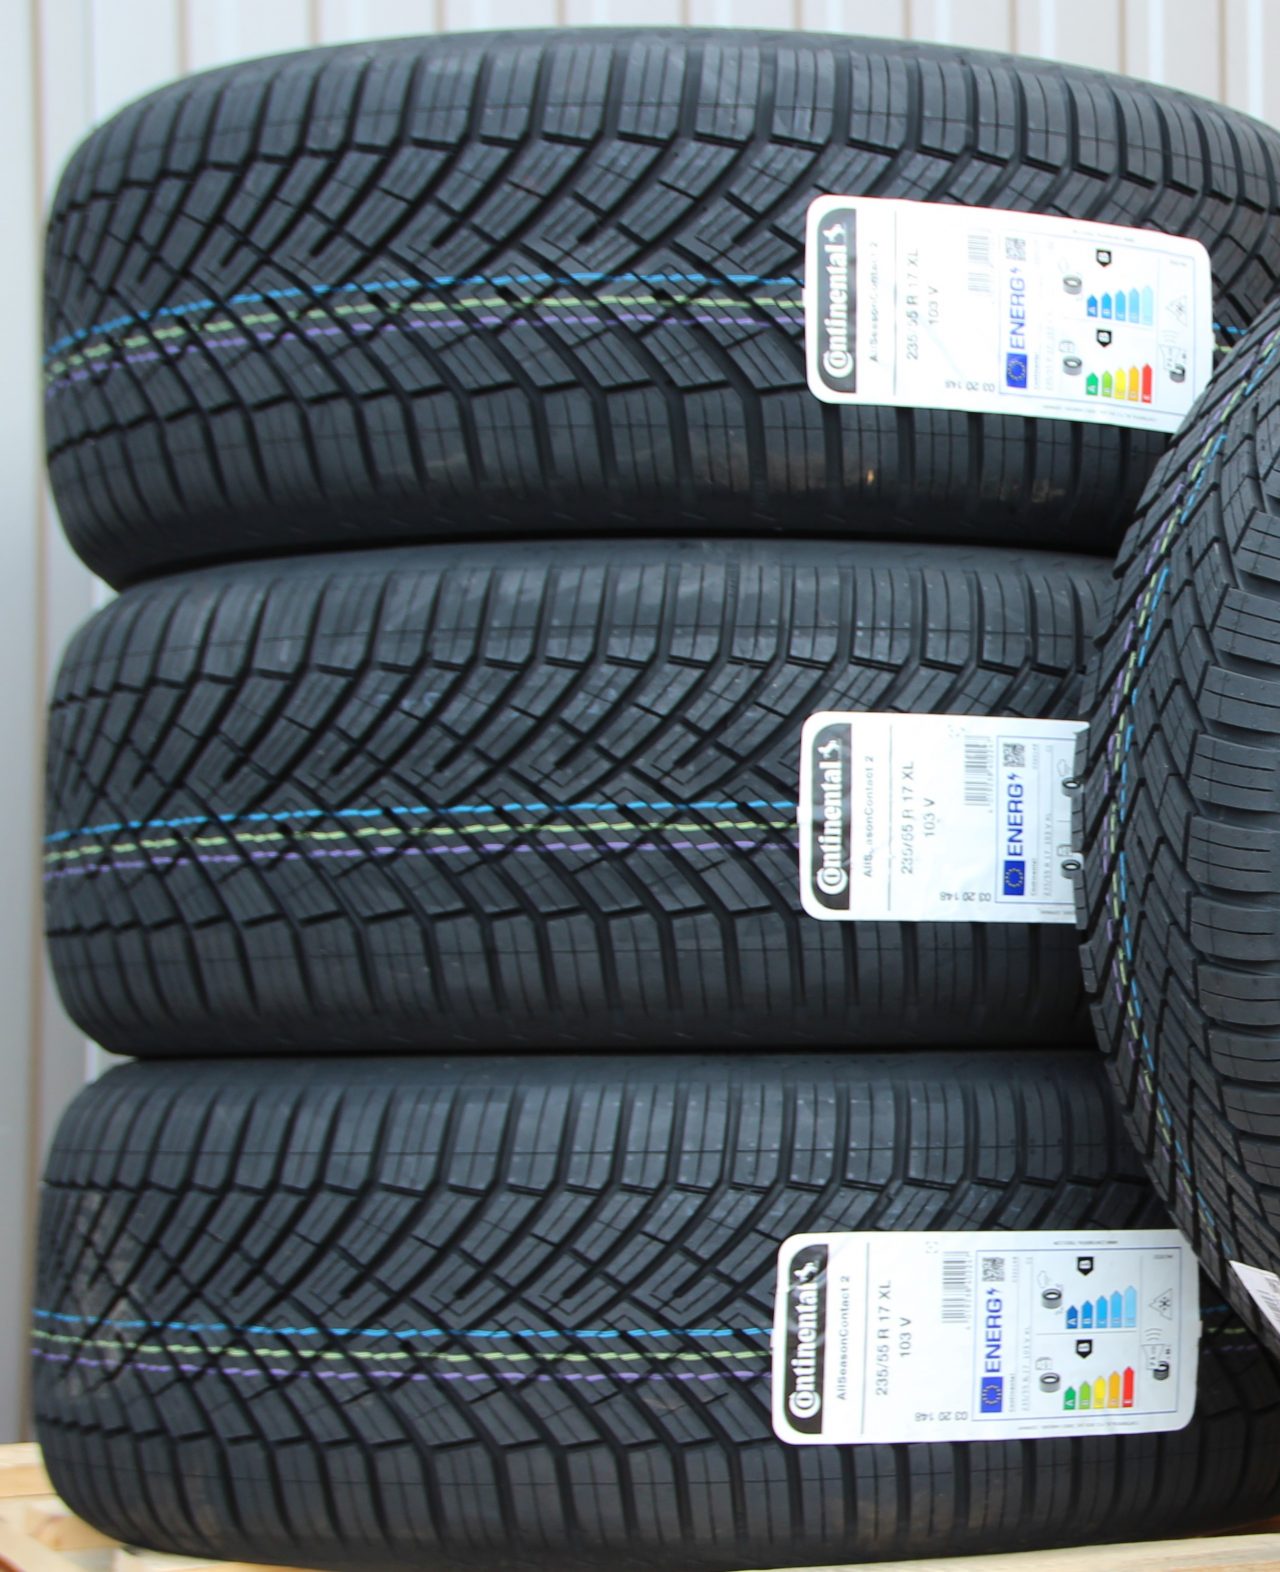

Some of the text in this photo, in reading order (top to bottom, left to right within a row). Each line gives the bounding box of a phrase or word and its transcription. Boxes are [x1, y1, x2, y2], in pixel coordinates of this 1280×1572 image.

[907, 248, 919, 268] XL
[823, 244, 854, 378] Continental
[906, 295, 919, 306] R
[928, 286, 940, 325] 103 V
[1010, 277, 1025, 350] ENERG
[965, 381, 980, 392] 20
[902, 761, 914, 780] XL
[902, 786, 914, 801] 17
[816, 761, 848, 895] Continental
[864, 768, 874, 878] AllSasonContact
[902, 809, 914, 819] R
[923, 798, 936, 837] 103 V
[1007, 783, 1024, 857] ENERG
[962, 892, 976, 902] 20
[978, 892, 991, 902] 03
[788, 1283, 821, 1418] Continental
[836, 1287, 849, 1400] AllSeasonContact
[876, 1280, 892, 1395] 235/55 R 17 XL
[900, 1317, 912, 1358] 103 V
[985, 1299, 1003, 1373] ENERG
[938, 1411, 952, 1421] 20
[955, 1411, 968, 1421] 03
